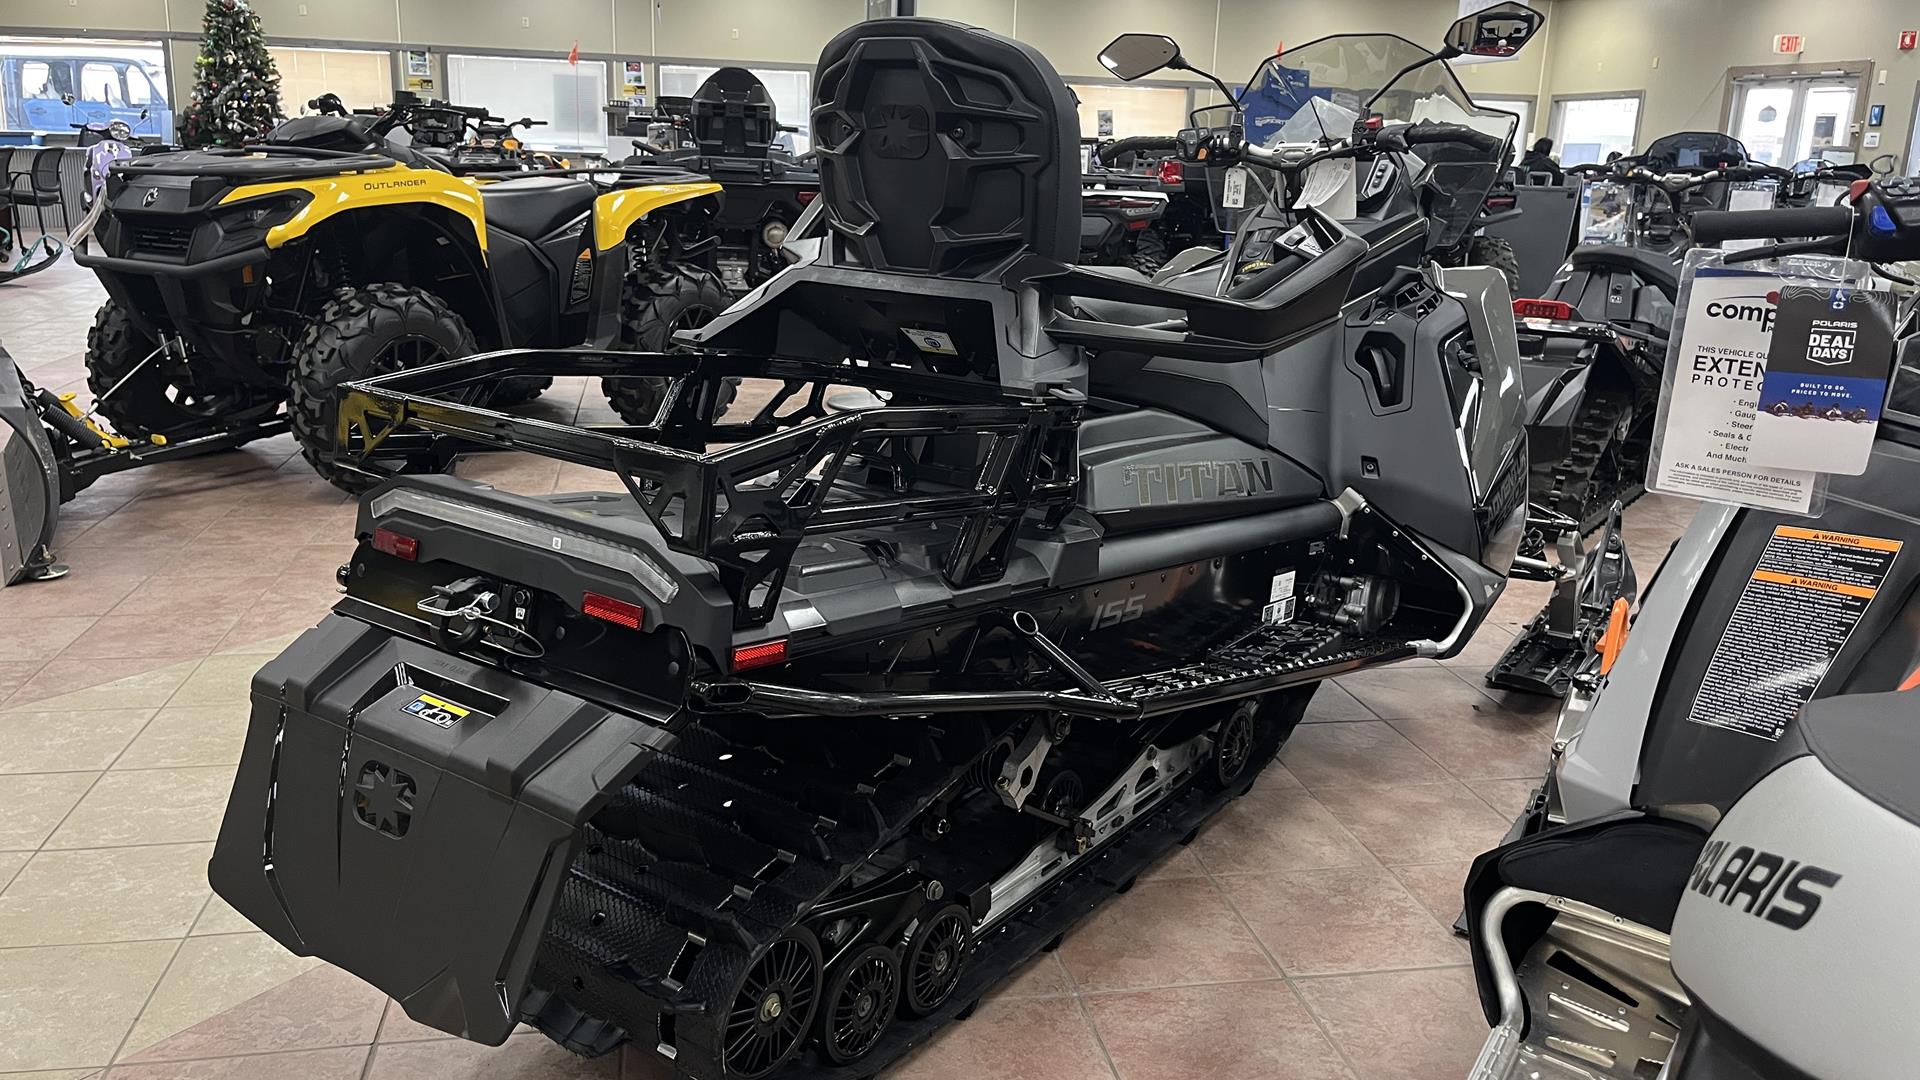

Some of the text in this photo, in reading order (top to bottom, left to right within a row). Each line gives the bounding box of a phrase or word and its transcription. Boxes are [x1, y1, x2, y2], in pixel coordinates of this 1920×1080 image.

[1780, 36, 1799, 52] EXIT
[363, 178, 427, 191] OUTLANDER
[1812, 320, 1858, 328] POLARIS
[1808, 334, 1855, 349] DEAL
[1697, 345, 1716, 354] THIS
[1718, 347, 1754, 358] VEHICLE
[1811, 347, 1848, 359] DAYS
[1713, 430, 1735, 439] Seals
[1706, 451, 1747, 463] And Much
[1123, 457, 1275, 506] TITAN
[1697, 465, 1720, 474] SALES
[1722, 469, 1752, 479] PERSON
[1753, 473, 1769, 482] FOR
[1770, 476, 1801, 487] DETAILS
[1821, 533, 1860, 545] WARNING
[1799, 579, 1838, 591] WARNING
[1089, 594, 1146, 631] 155
